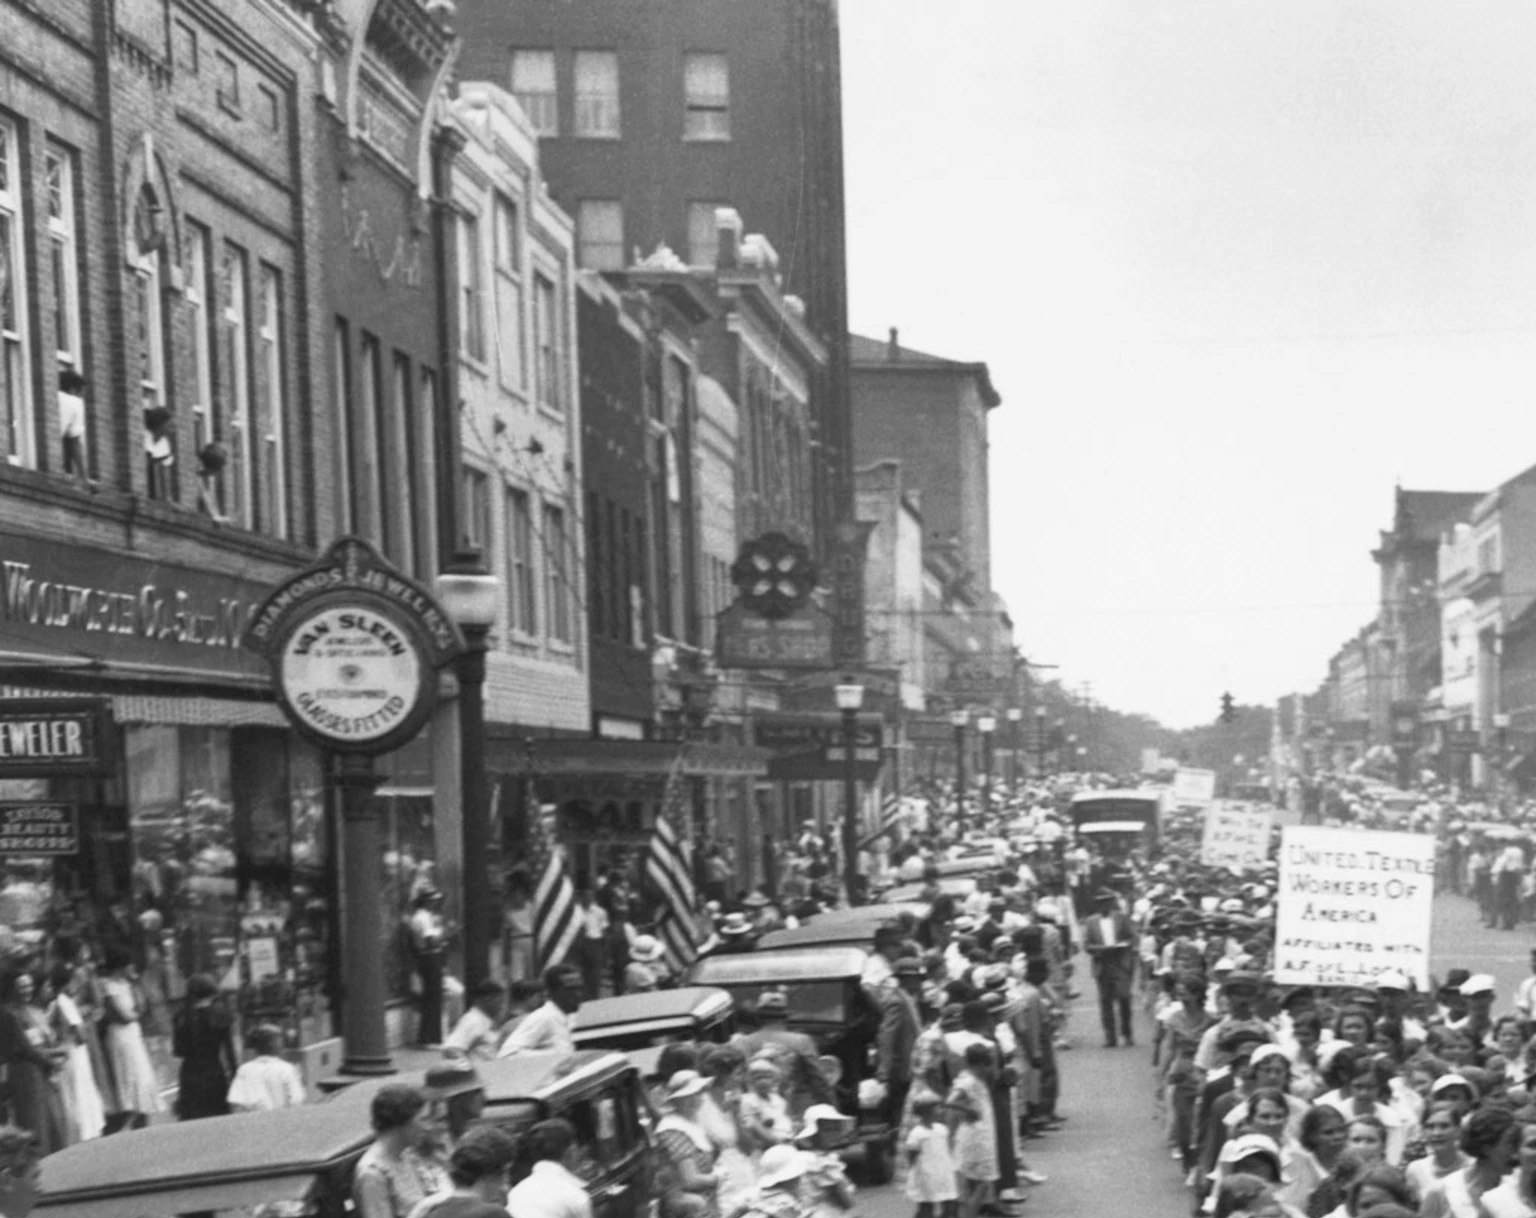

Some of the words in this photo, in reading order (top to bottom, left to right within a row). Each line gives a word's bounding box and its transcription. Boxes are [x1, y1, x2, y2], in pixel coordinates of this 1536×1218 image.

[253, 568, 343, 637] DIAMONDS
[294, 622, 330, 655] VAN
[354, 696, 405, 733] FITTED
[1289, 844, 1358, 869] UNITED
[1365, 852, 1434, 875] TEXTILE
[1288, 873, 1379, 897] WORKERS
[1385, 879, 1417, 899] OF
[1301, 903, 1376, 923] AMERICA
[1284, 938, 1373, 953] AFFILIATED
[1384, 945, 1422, 953] WITH
